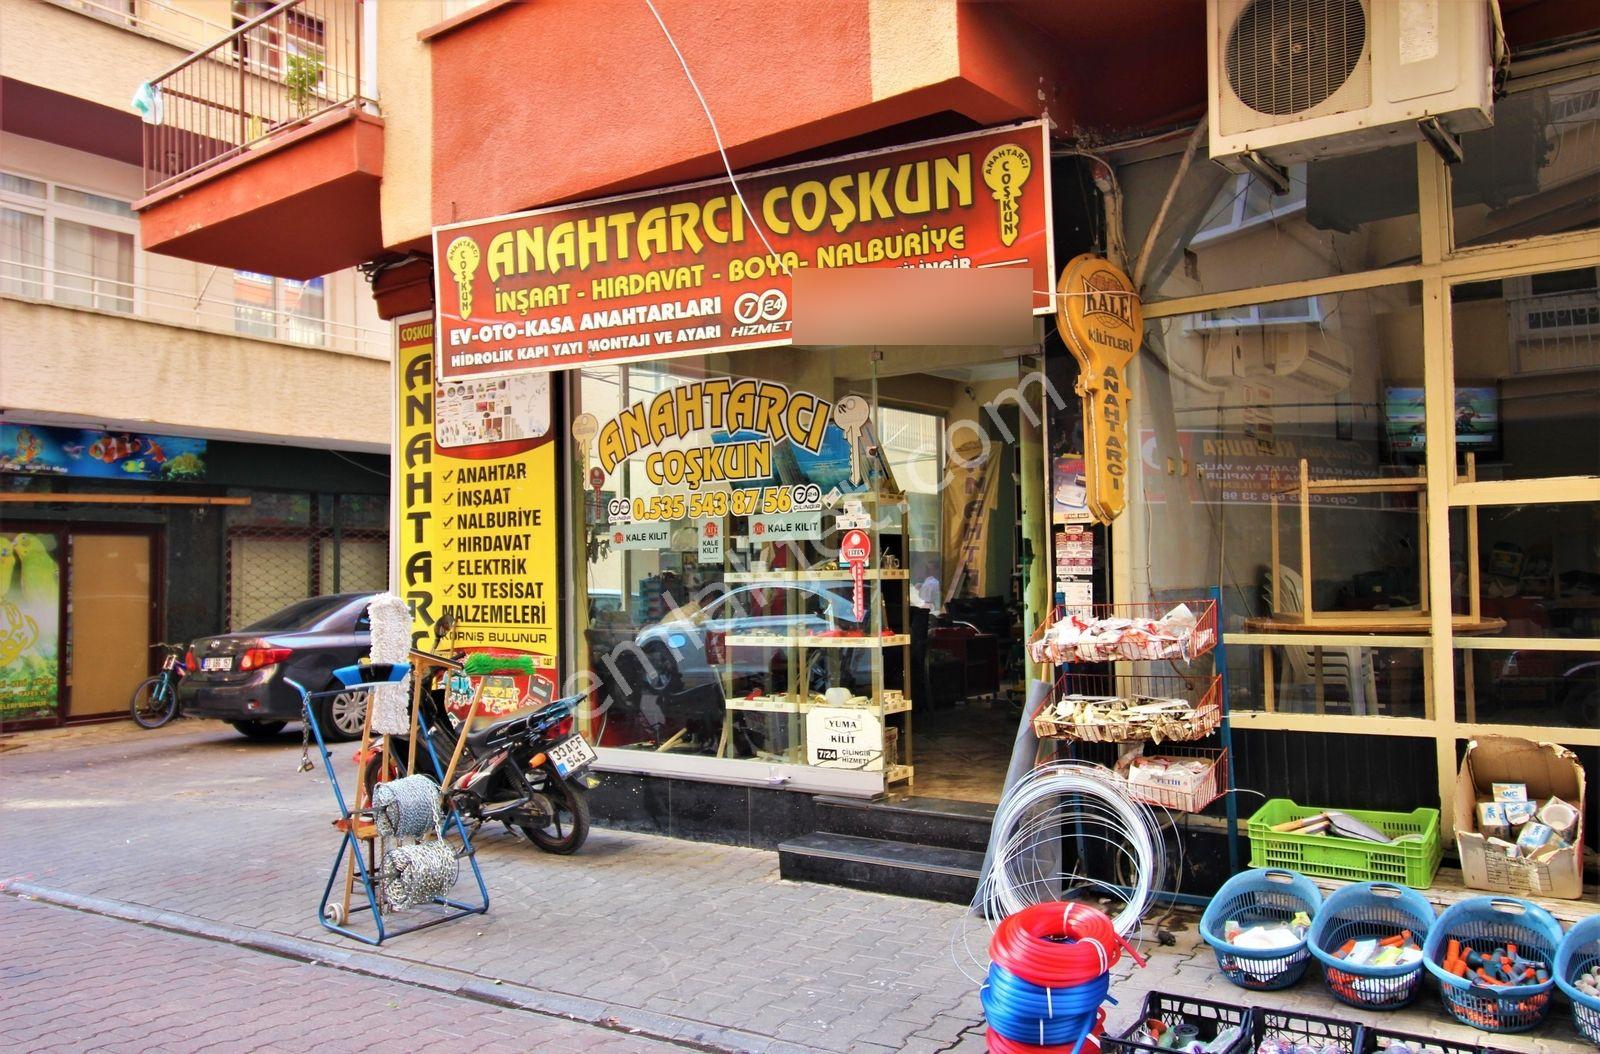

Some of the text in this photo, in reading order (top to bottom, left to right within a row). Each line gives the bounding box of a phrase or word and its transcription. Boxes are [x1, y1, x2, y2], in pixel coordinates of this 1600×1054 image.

[985, 148, 1029, 175] ANAHTARCI
[486, 153, 972, 283] ANAHTARCI COŞKUN
[495, 283, 570, 316] İNŞAAT
[592, 264, 705, 301] HIRDAVAT
[817, 223, 965, 268] NALBURİYE
[765, 299, 782, 312] 24
[1086, 284, 1130, 323] KALE
[450, 296, 722, 346] EV-OTO-KASA ANAHTARLARI
[450, 325, 721, 368] HİDROLİK KAPI YAYI MONTAJI VE AYARI
[1088, 328, 1134, 353] KİLİTLERİ
[598, 377, 832, 475] ANAHTARCI
[1103, 365, 1123, 490] ANAHTARCI
[456, 463, 527, 484] ANAHTAR
[645, 440, 772, 490] COŞKUN
[457, 487, 511, 508] İNŞAAT
[632, 486, 793, 521] 0.535 543 87 56
[457, 508, 542, 530] NALBURİYE
[768, 523, 792, 533] KALE
[457, 533, 531, 553] HIRDAVAT
[626, 532, 646, 542] KALE
[457, 555, 527, 576] ELEKTRİK
[457, 579, 544, 599] SU TESİSAT
[441, 601, 546, 625] MALZEMELERİ
[488, 632, 547, 643] BULUNUR
[829, 720, 857, 728] YUMA
[831, 734, 856, 743] KİLİT
[553, 747, 567, 761] 33
[566, 750, 587, 768] 545
[818, 750, 837, 760] 7/24
